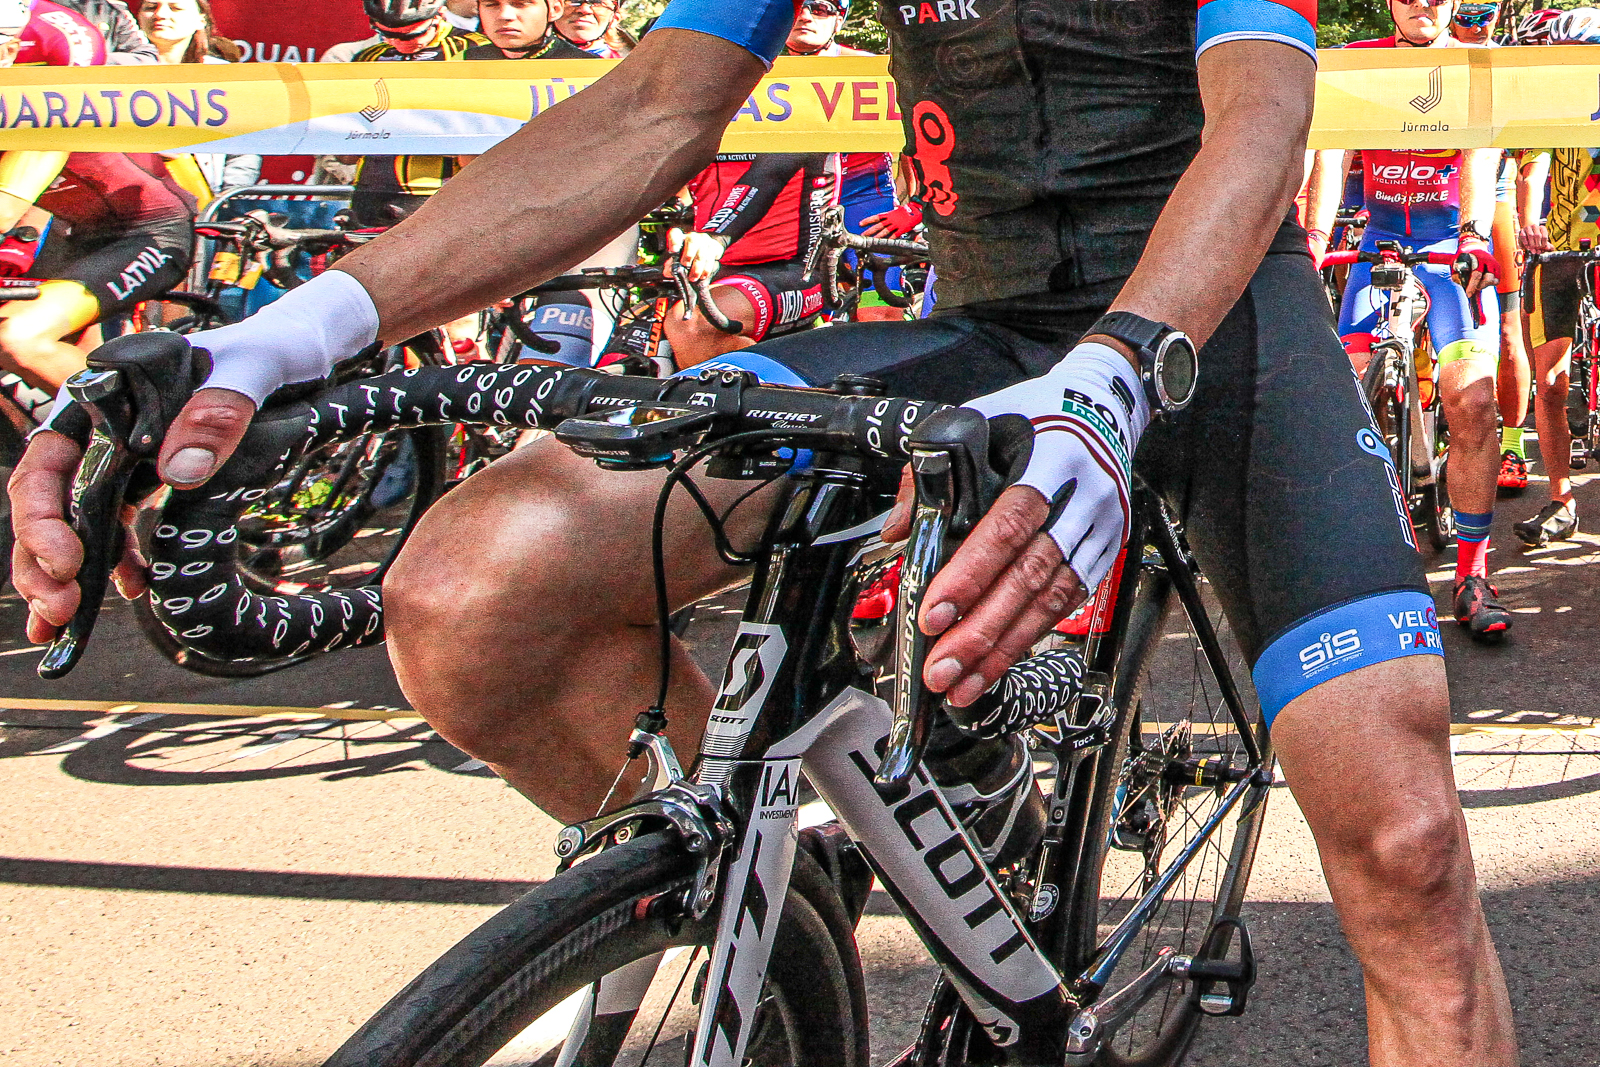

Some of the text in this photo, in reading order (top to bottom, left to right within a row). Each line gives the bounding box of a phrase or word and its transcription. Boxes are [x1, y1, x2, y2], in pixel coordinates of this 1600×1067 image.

[0, 89, 229, 129] ARATONS
[811, 81, 901, 121] VEL
[1401, 120, 1449, 133] Jūrmala
[1417, 178, 1449, 186] CLUB
[106, 246, 173, 301] LATVIA
[746, 408, 823, 424] RITCHEY
[708, 713, 750, 727] SCOTT
[1071, 734, 1096, 750] Tacx
[849, 728, 1037, 969] SCOTT
